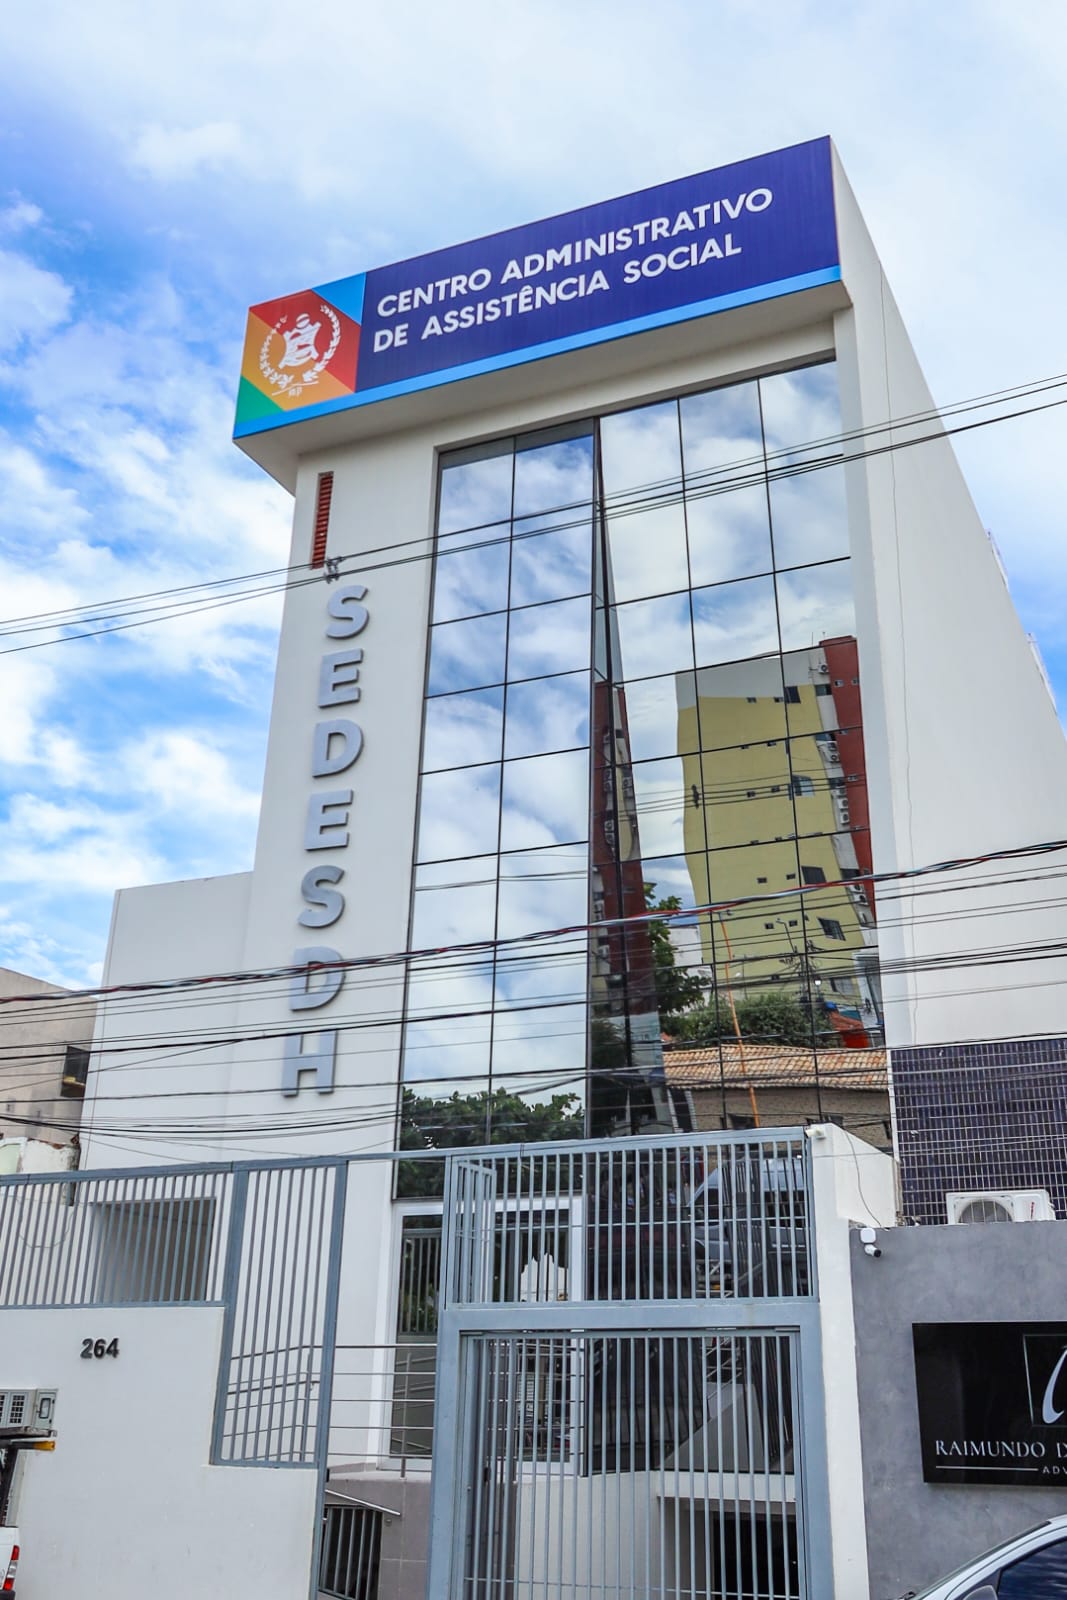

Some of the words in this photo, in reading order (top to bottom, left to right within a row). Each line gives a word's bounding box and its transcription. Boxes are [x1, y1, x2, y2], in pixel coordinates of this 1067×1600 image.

[373, 323, 408, 353] DE
[421, 269, 609, 340] ASSISTÊNCIA
[623, 233, 742, 284] SOCIAL
[377, 268, 491, 317] CENTRO
[500, 188, 773, 285] ADMINISTRATIVO
[281, 584, 369, 1098] SEDESDH
[80, 1337, 120, 1359] 264
[935, 1439, 1046, 1458] RAIMUNDO
